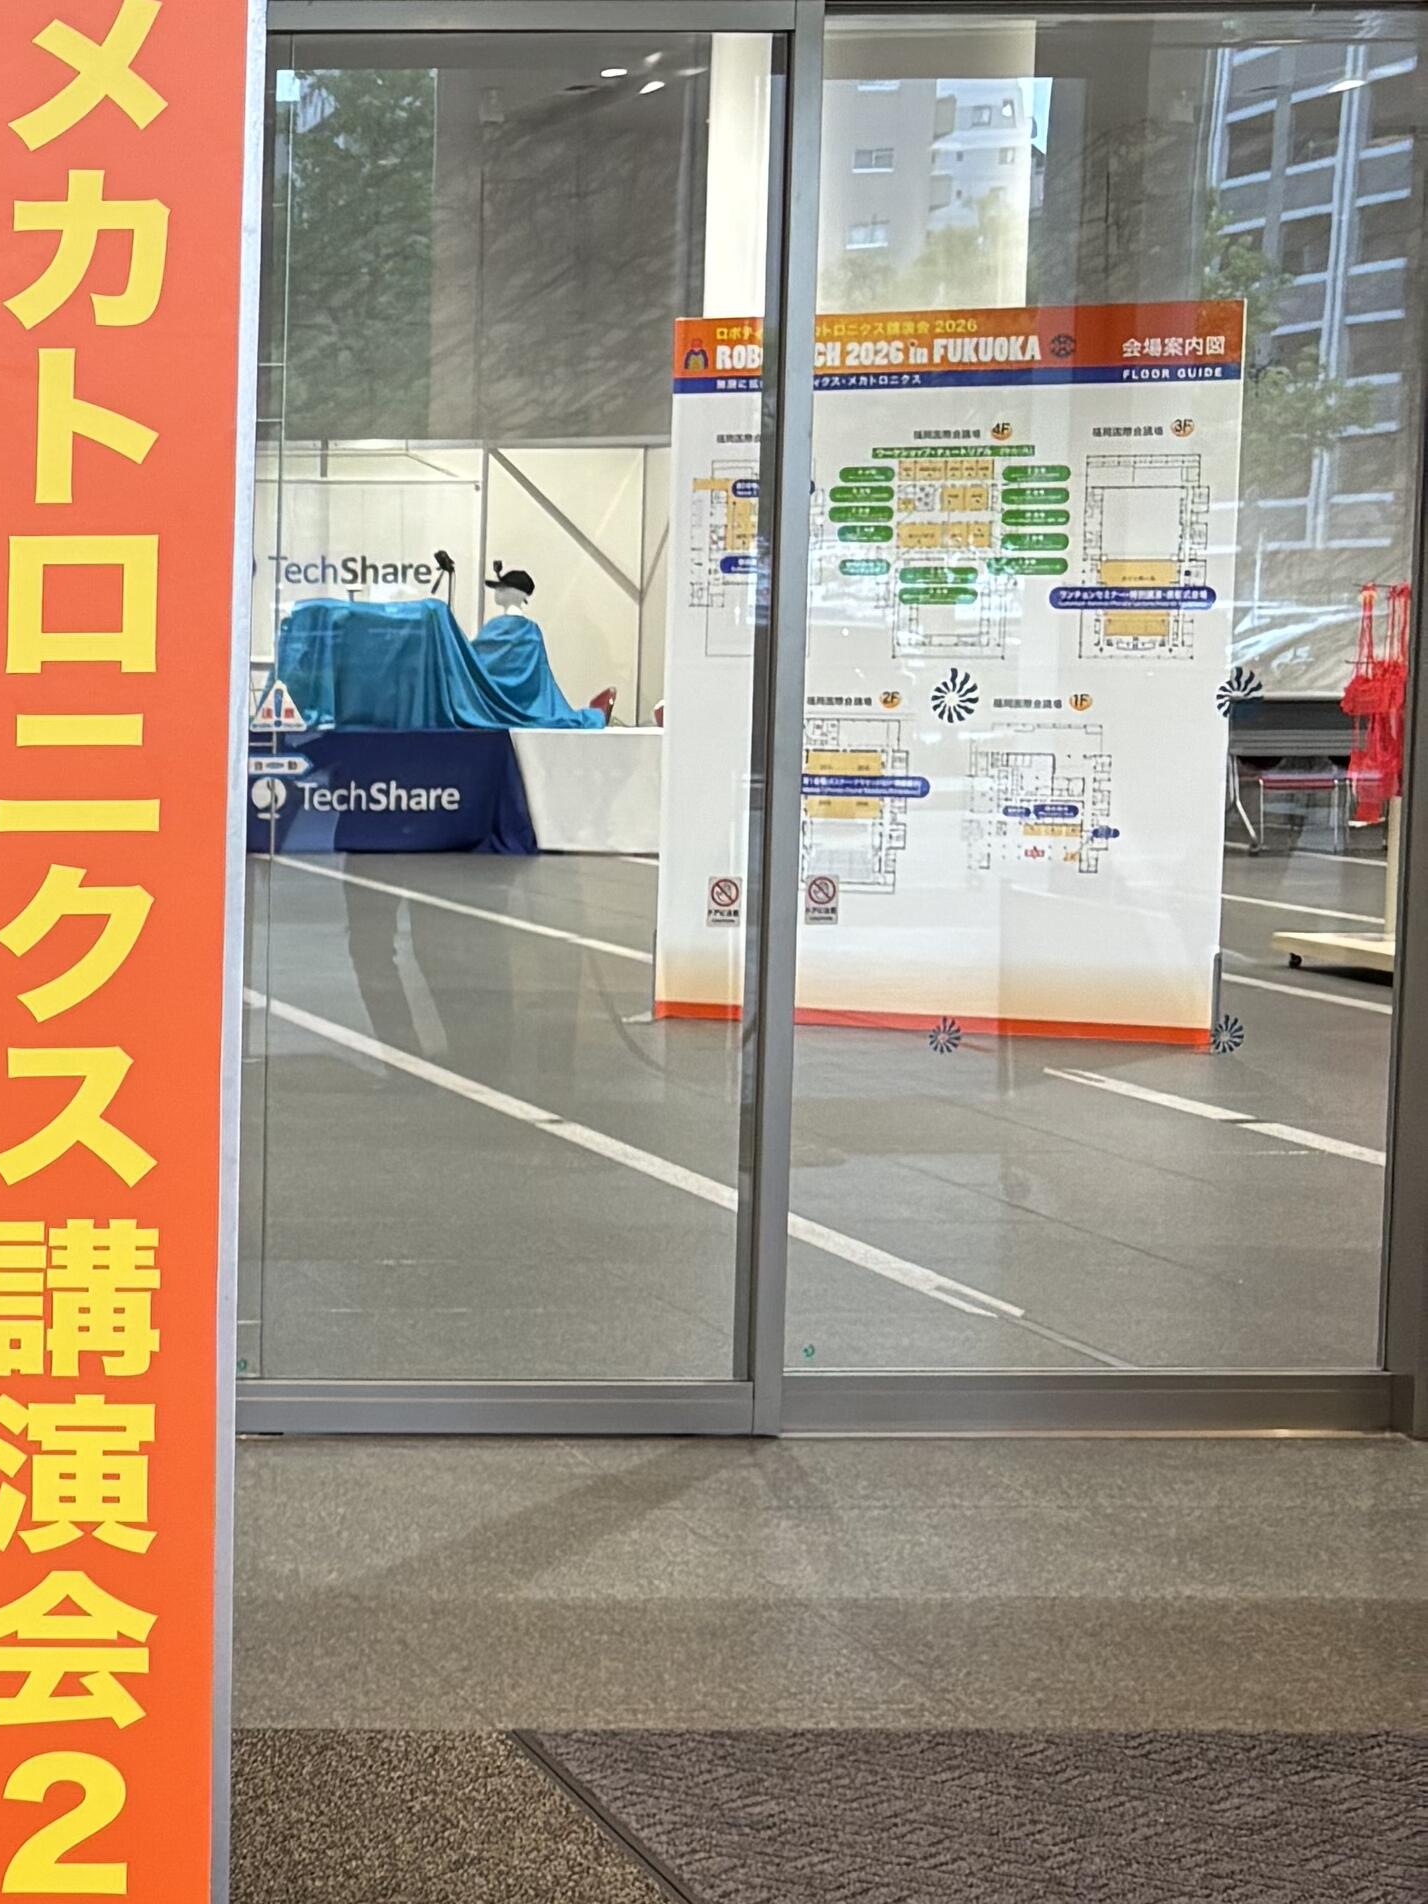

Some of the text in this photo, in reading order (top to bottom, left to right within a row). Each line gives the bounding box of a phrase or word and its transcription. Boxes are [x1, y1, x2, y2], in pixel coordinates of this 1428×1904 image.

[935, 319, 977, 333] 2026
[846, 340, 904, 367] 2026
[909, 339, 929, 365] in
[933, 335, 1041, 364] FUKUOKA
[1122, 336, 1225, 358] 会場案内図
[1122, 367, 1223, 380] FLOOR GUIDE
[992, 422, 1011, 435] 4F
[1174, 419, 1193, 434] 3F
[268, 555, 432, 584] TechShare
[297, 780, 460, 812] TechShare
